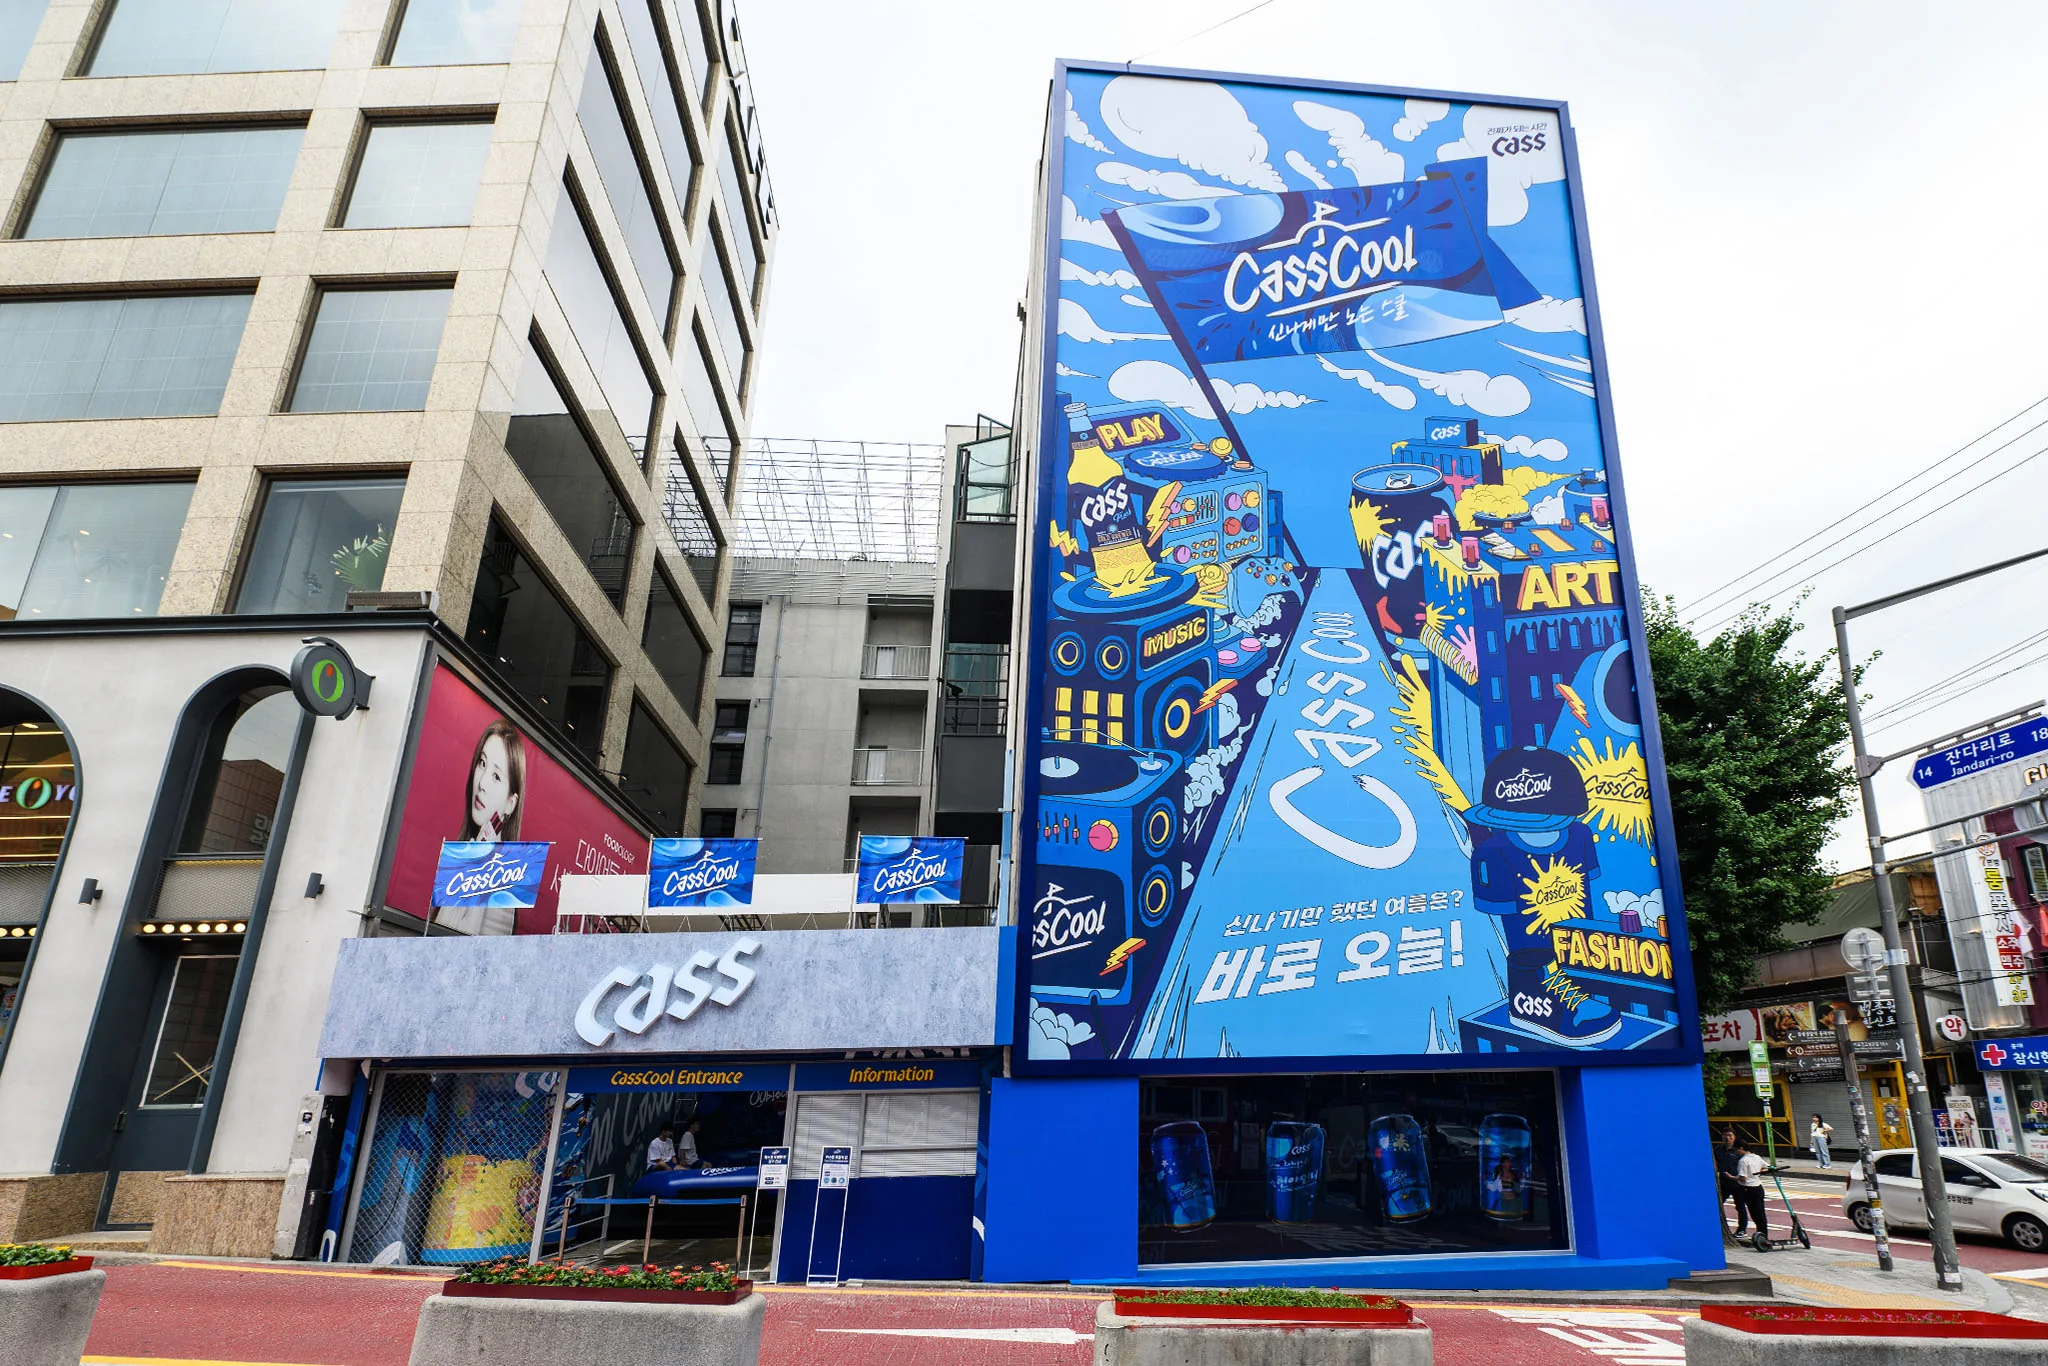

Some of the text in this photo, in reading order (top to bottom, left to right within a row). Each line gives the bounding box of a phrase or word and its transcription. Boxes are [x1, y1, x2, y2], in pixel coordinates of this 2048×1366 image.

[1224, 225, 1418, 313] CassCool
[1096, 413, 1165, 450] PLAY
[1517, 559, 1620, 611] ART
[1144, 617, 1207, 657] MUSIC
[1946, 732, 2015, 766] 잔다리로
[2030, 727, 2048, 742] 18
[1917, 765, 1934, 780] 14
[1951, 751, 2015, 777] Jandari-ro
[1495, 775, 1552, 799] CassCool
[446, 863, 529, 896] CassCool
[663, 860, 740, 897] CassCool
[873, 858, 948, 894] CassCool
[1329, 899, 1378, 923] 했던
[1384, 889, 1464, 916] 여름은?
[1193, 919, 1464, 1005] 바로 오늘!
[1945, 1017, 1963, 1037] 약
[611, 1069, 744, 1086] CassCool Entrance
[849, 1065, 935, 1083] Information
